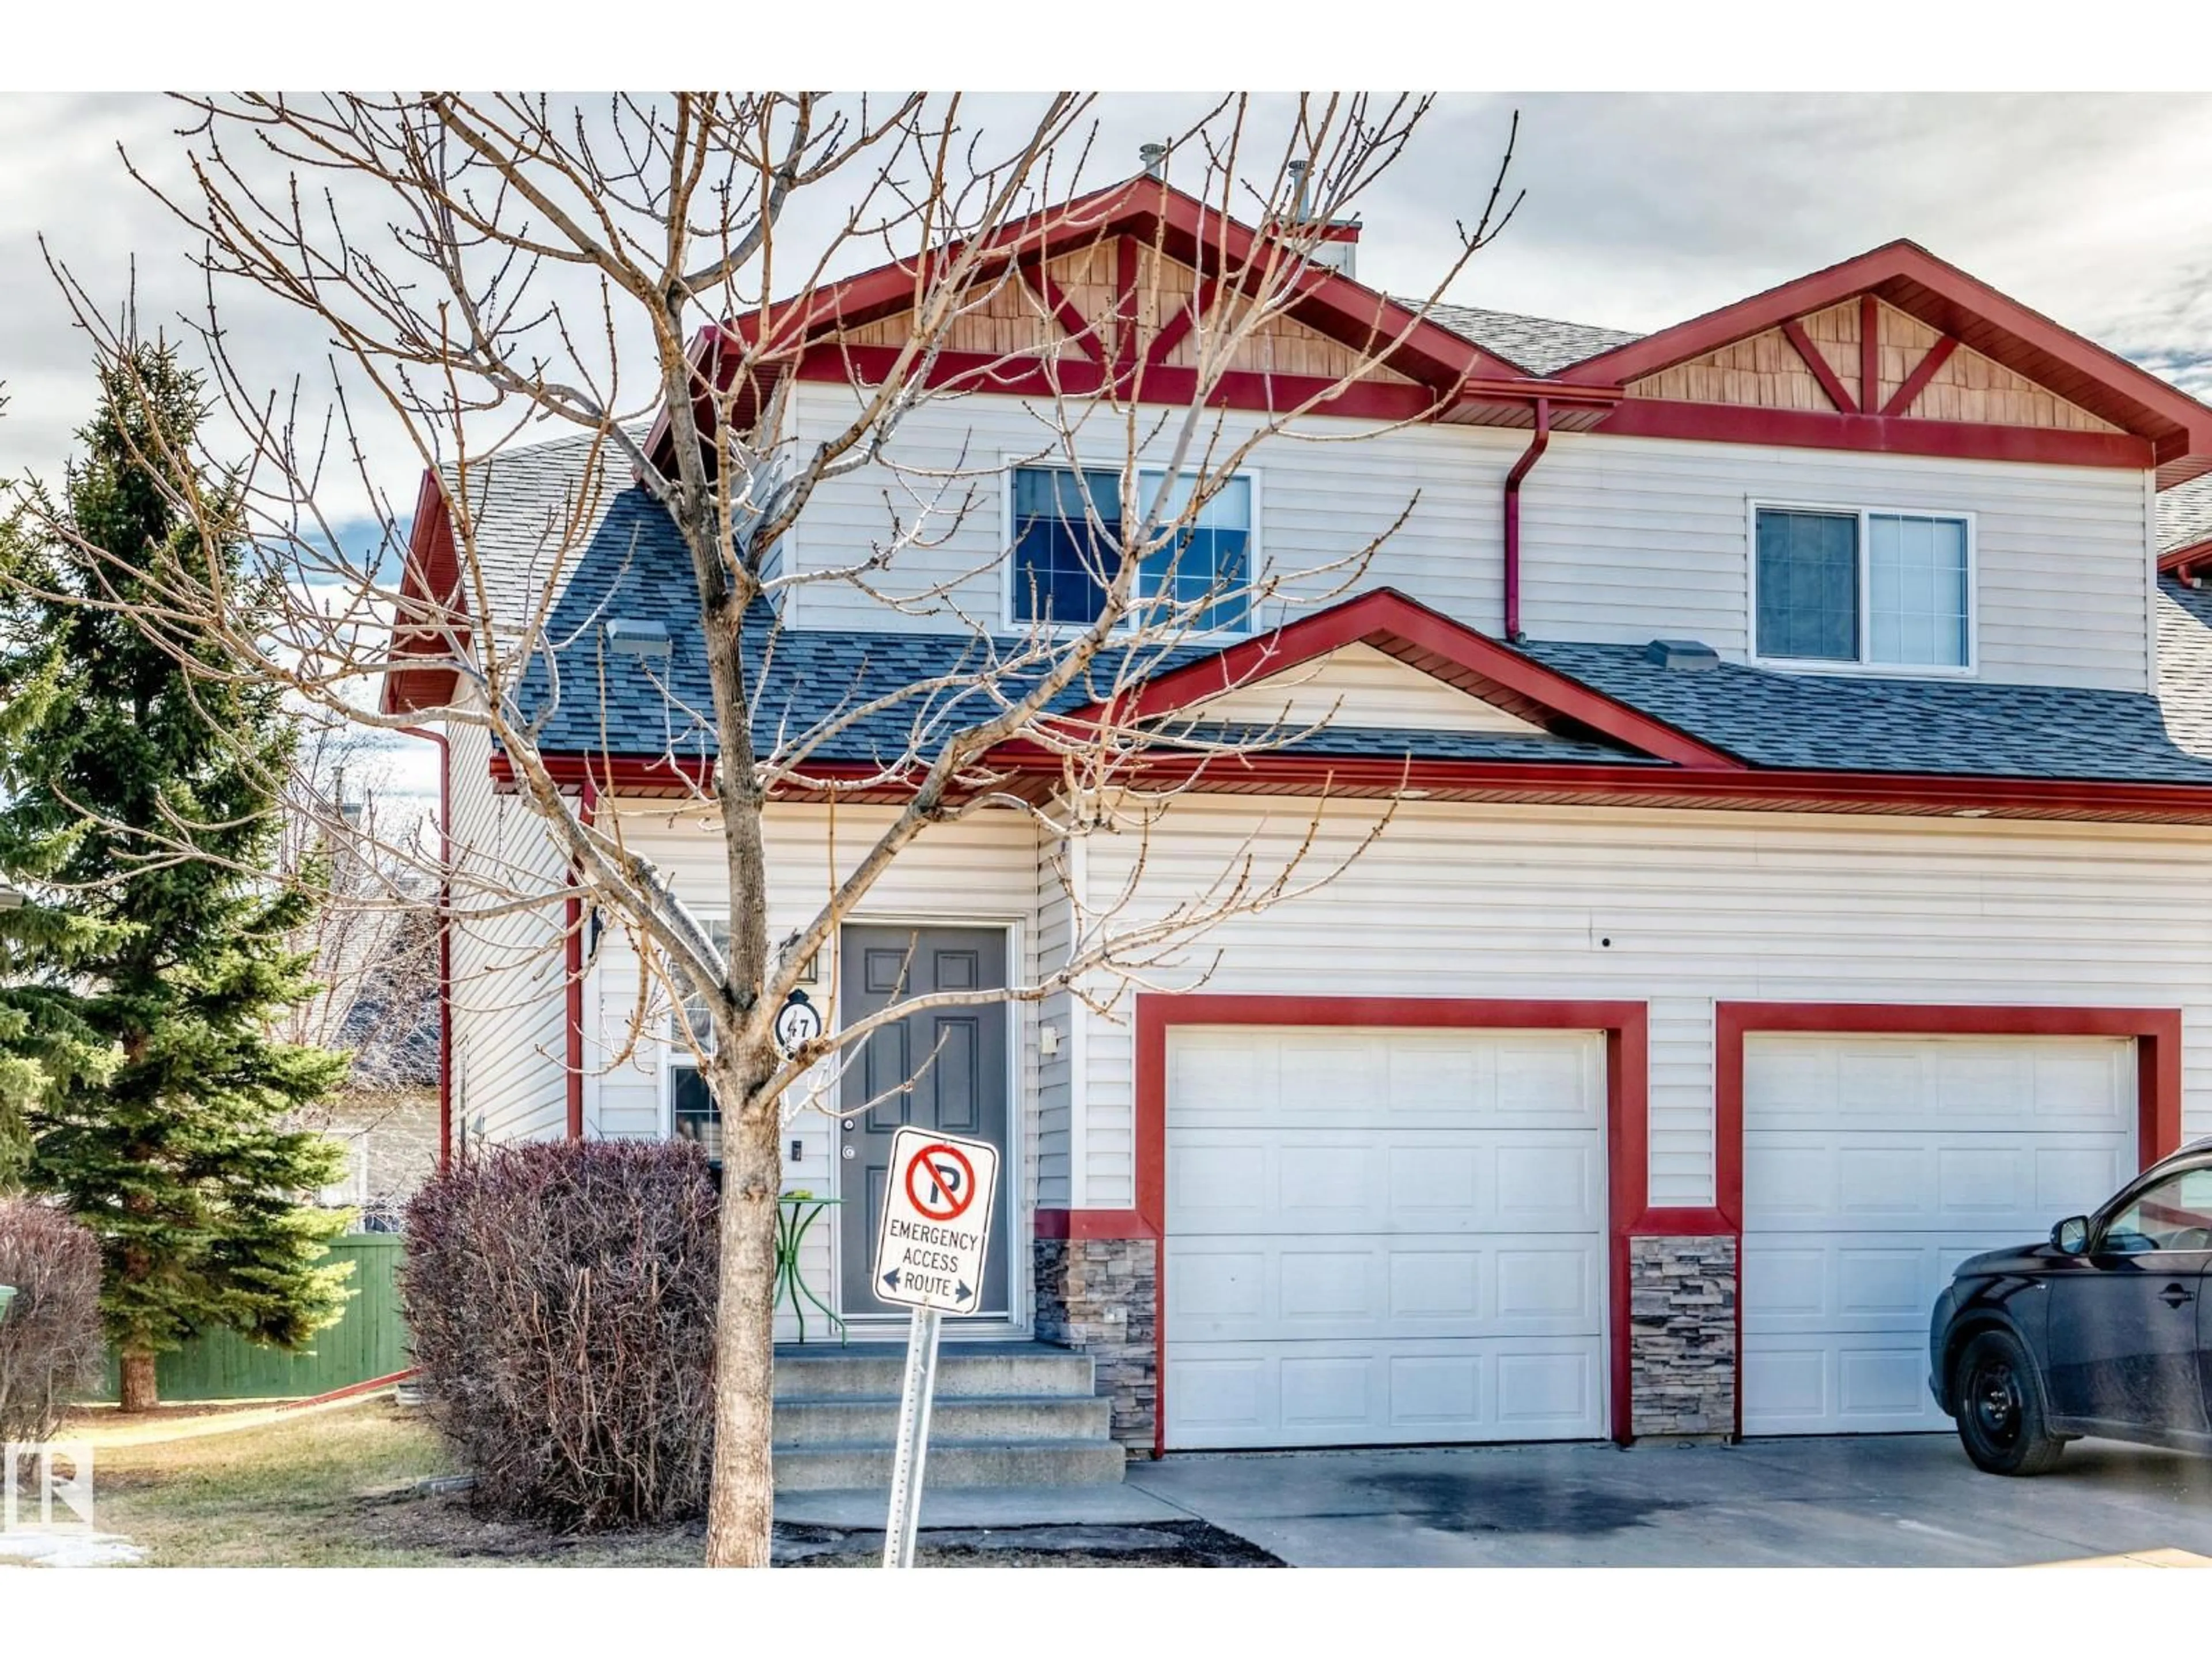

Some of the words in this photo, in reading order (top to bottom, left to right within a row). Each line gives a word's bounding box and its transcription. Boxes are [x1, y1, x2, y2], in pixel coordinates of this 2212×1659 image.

[787, 1018, 809, 1037] 47
[930, 1164, 961, 1204] P
[890, 1219, 978, 1251] EMERGENCY
[903, 1247, 959, 1272] ACCESS
[904, 1272, 952, 1297] ROUTE
